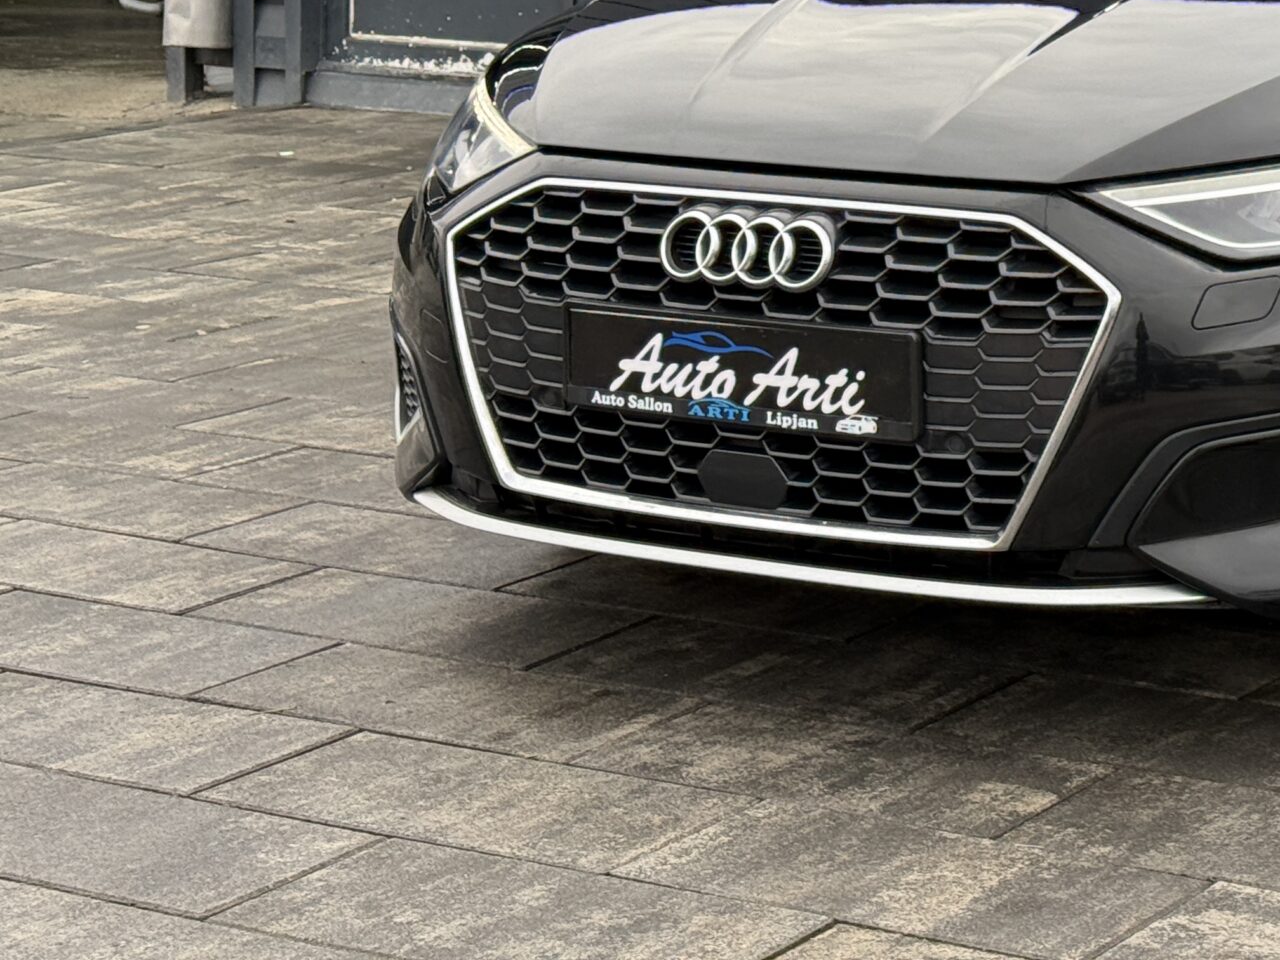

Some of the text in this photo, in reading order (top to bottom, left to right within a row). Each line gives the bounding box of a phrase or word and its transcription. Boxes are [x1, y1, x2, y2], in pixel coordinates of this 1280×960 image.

[609, 332, 866, 416] Auto Arti
[591, 390, 819, 431] Auto Sallon ARTI Lipjan
